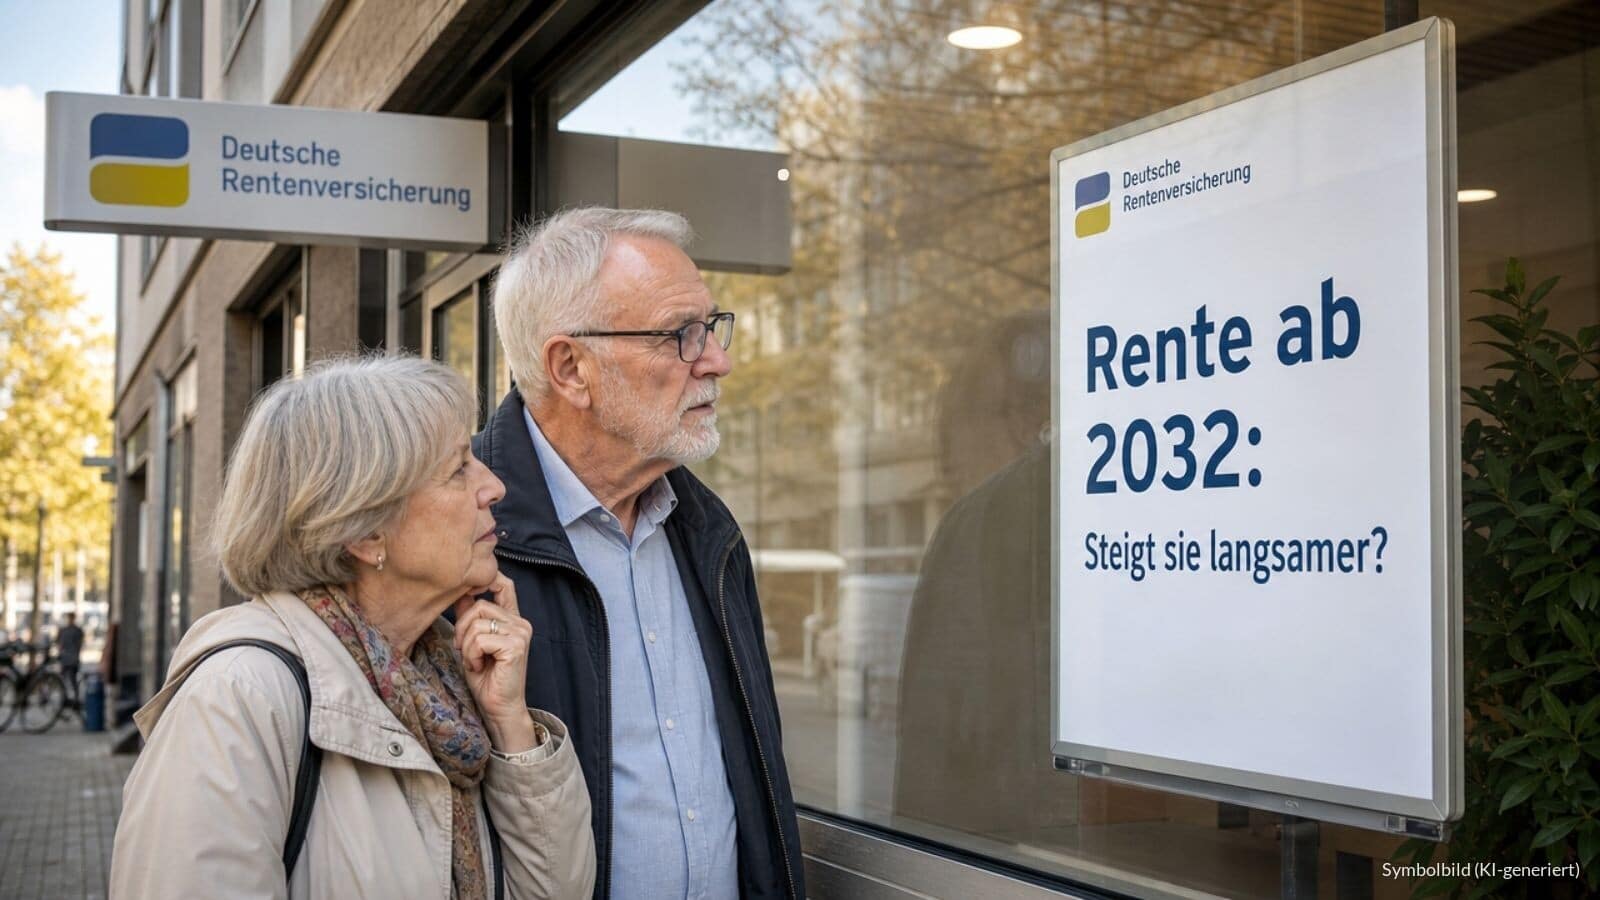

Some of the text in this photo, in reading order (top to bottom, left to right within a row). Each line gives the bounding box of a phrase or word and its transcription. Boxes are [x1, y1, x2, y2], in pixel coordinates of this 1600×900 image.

[221, 135, 341, 167] Deutsche
[1123, 157, 1181, 189] Deutsche
[221, 168, 472, 212] Rentenversicherung
[1123, 162, 1252, 213] Rentenversicherung
[1086, 277, 1362, 393] Rente ab
[1086, 409, 1262, 495] 2032:
[1084, 526, 1389, 585] Steigt sie langsamer?
